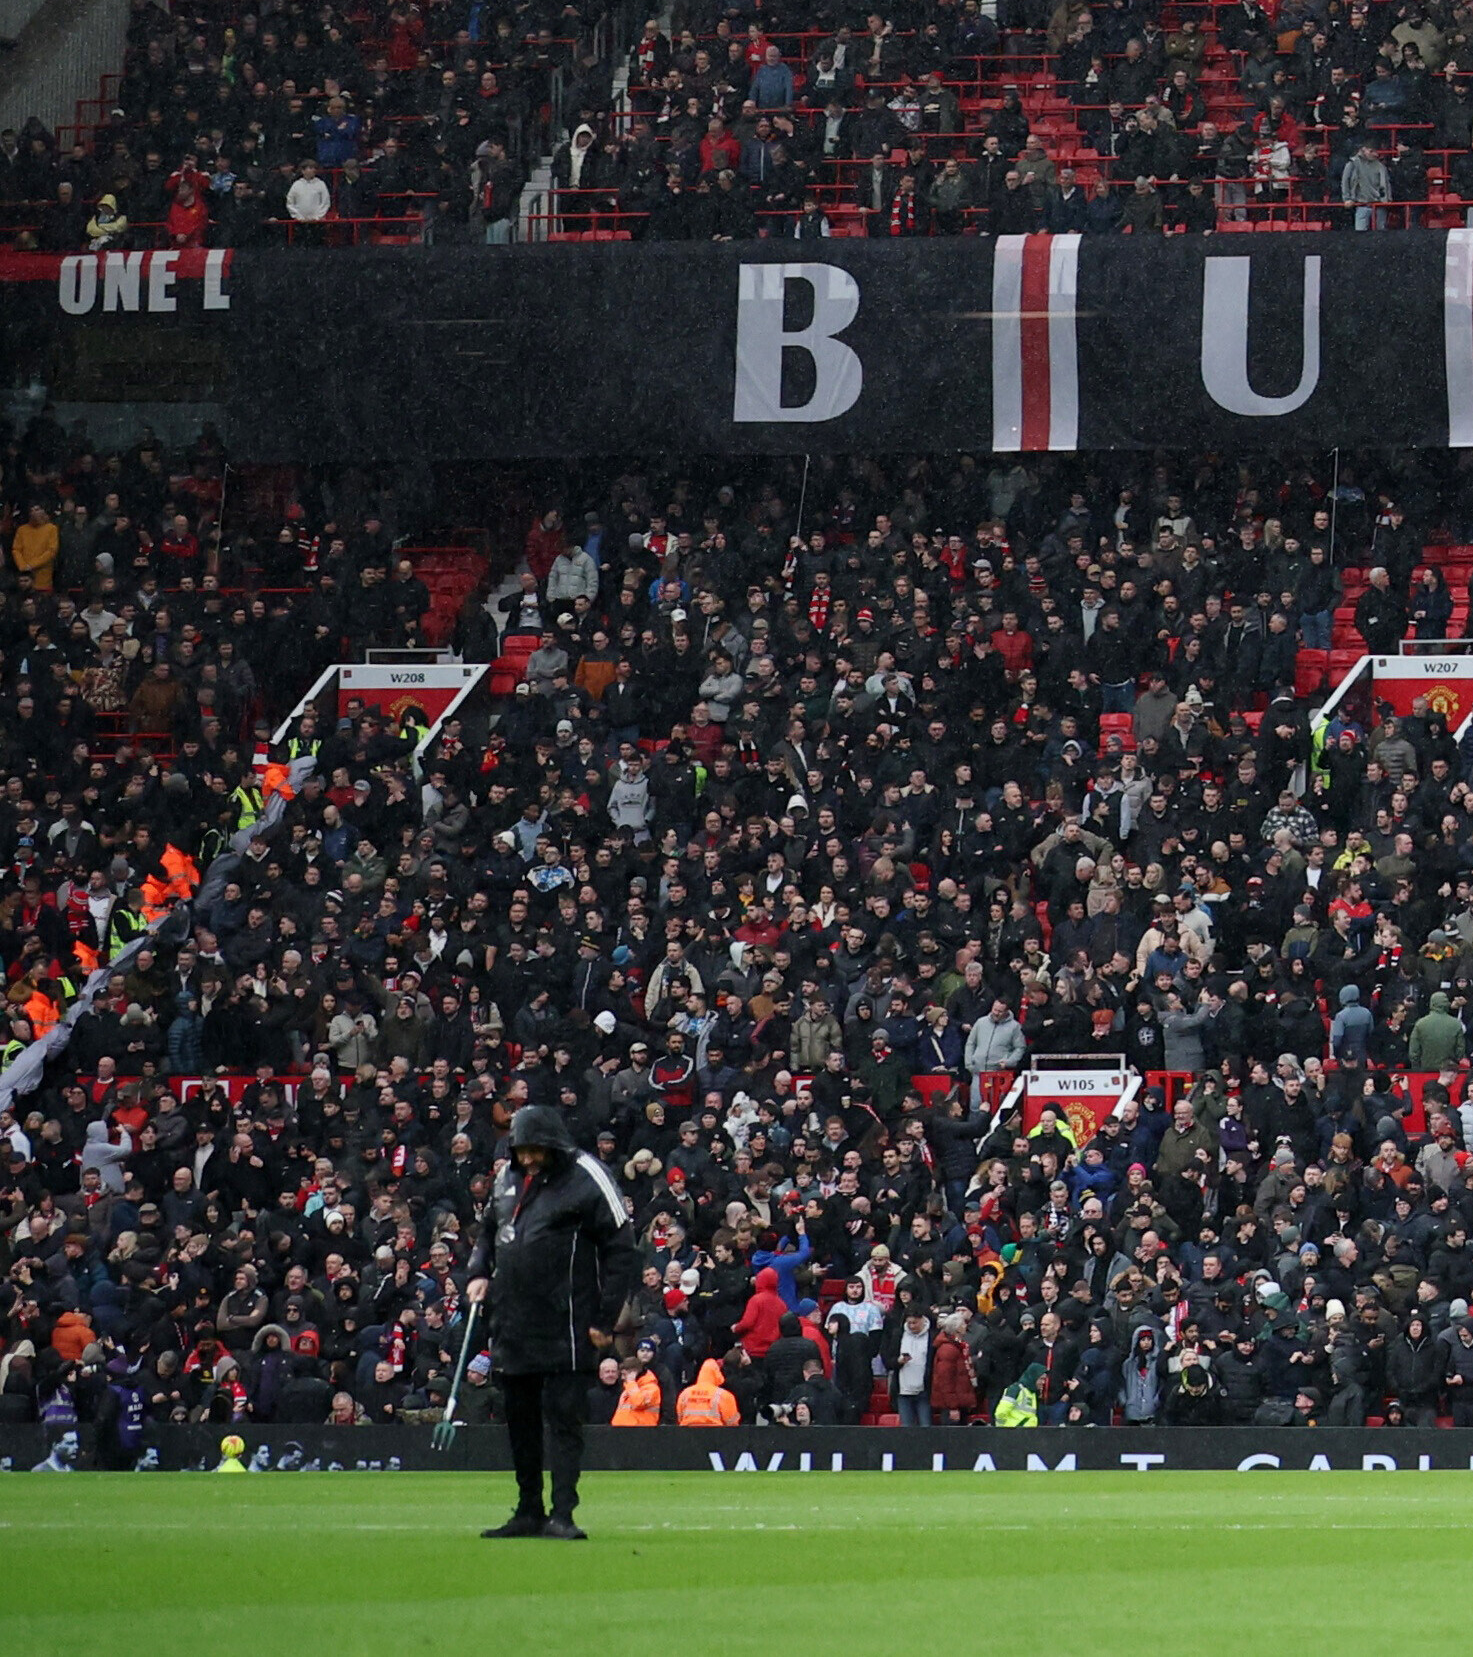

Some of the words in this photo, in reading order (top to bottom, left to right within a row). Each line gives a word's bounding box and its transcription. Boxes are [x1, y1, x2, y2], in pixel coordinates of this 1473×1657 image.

[59, 249, 181, 316] ONE
[1424, 662, 1459, 674] W207
[390, 672, 425, 684] W208
[1057, 1079, 1095, 1091] W105
